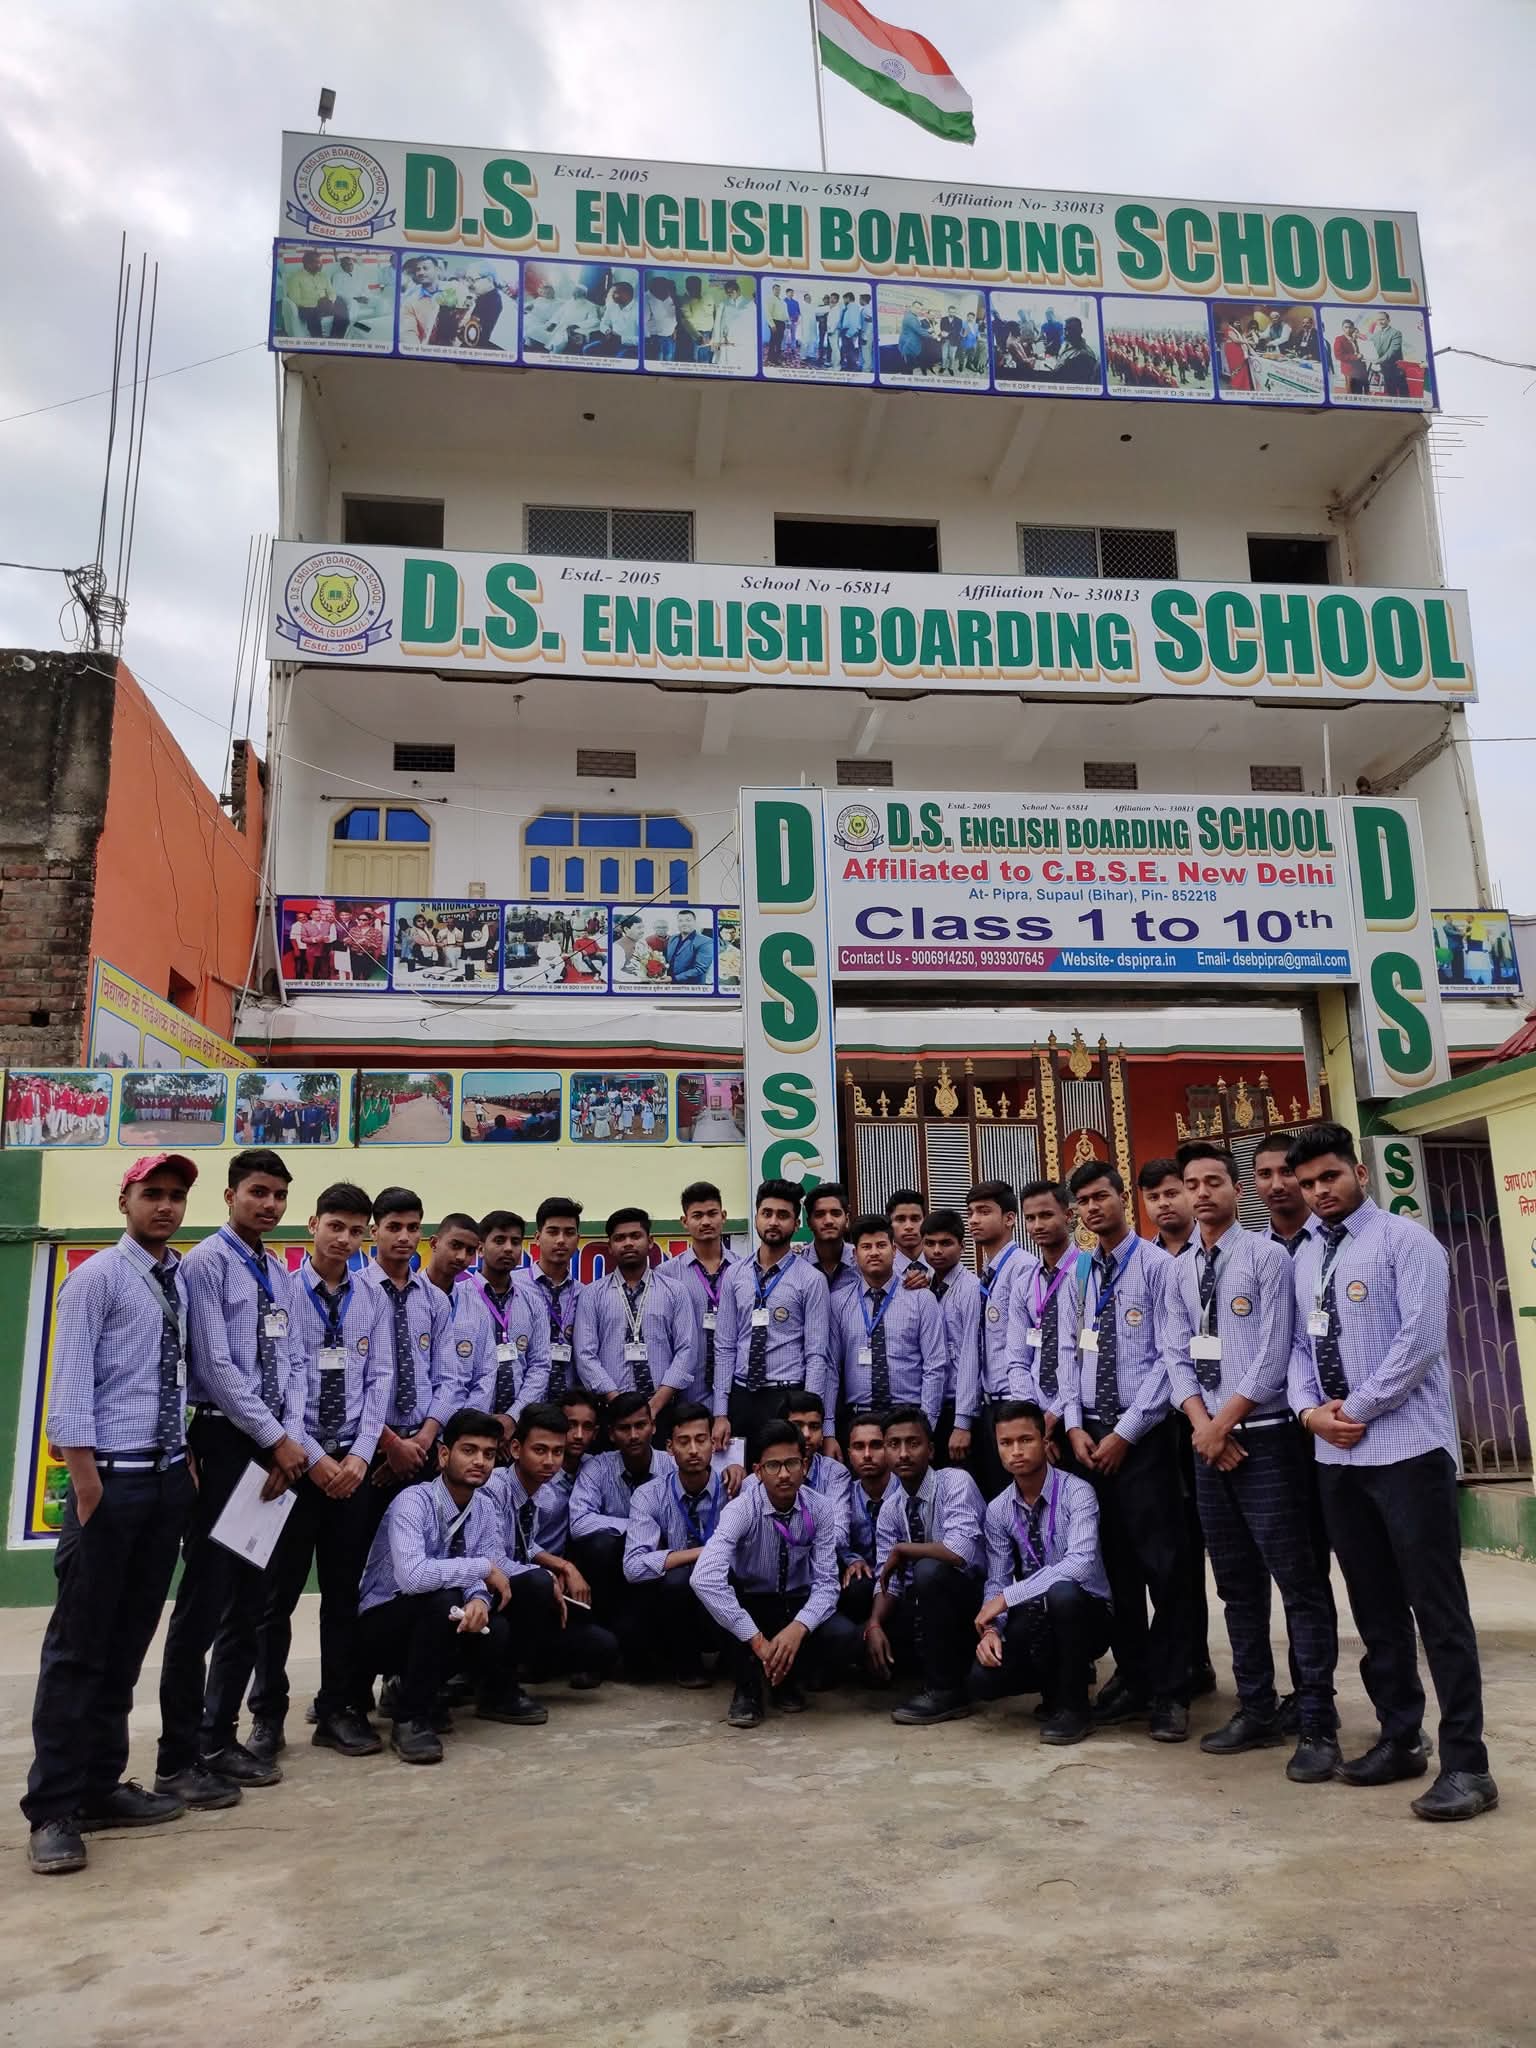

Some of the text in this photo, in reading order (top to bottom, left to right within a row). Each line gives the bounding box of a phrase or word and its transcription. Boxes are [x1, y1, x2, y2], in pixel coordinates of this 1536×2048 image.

[303, 149, 330, 174] ENGLISH
[332, 148, 372, 167] BOARDING
[609, 169, 649, 183] 2005
[724, 176, 781, 192] School
[824, 183, 870, 198] 65814
[933, 192, 1105, 215] Affiliation No- 330813
[345, 228, 370, 237] 2005
[402, 152, 1418, 301] D.S. ENGLISH BOARDING SCHOOL
[295, 558, 324, 584] ENGLISH
[326, 555, 369, 574] BOARDING
[366, 573, 382, 605] SCHOOL
[618, 571, 661, 585] 2005
[741, 575, 800, 592] School
[958, 584, 1140, 602] Affiliation No- 330813
[299, 612, 325, 635] PIPRA
[400, 558, 1470, 688] D.S. ENGLISH BOARDING SCHOOL
[339, 642, 364, 653] 2005
[972, 803, 991, 811] 2005
[1021, 803, 1048, 811] School
[1066, 804, 1089, 812] 65814
[1112, 804, 1151, 813] Affiliation
[886, 801, 953, 852] D.S.
[960, 816, 1061, 853] ENGLISH
[1066, 817, 1191, 854] BOARDING
[1197, 806, 1335, 856] SCHOOL
[842, 858, 1335, 886] Affiliated to C.B.S.E. New Delhi
[969, 888, 1217, 903] At- Pipra, Supaul (Bihar), Pin- 852218
[855, 906, 1334, 943] Class 1 to 10th
[841, 951, 884, 966] Contact
[887, 951, 902, 965] Us
[911, 950, 978, 968] 9006914250,
[980, 951, 1045, 966] 9939307645
[1061, 951, 1177, 970] Website- dspipra.in
[1197, 952, 1347, 970] Email- dsebpipra@gmail.com
